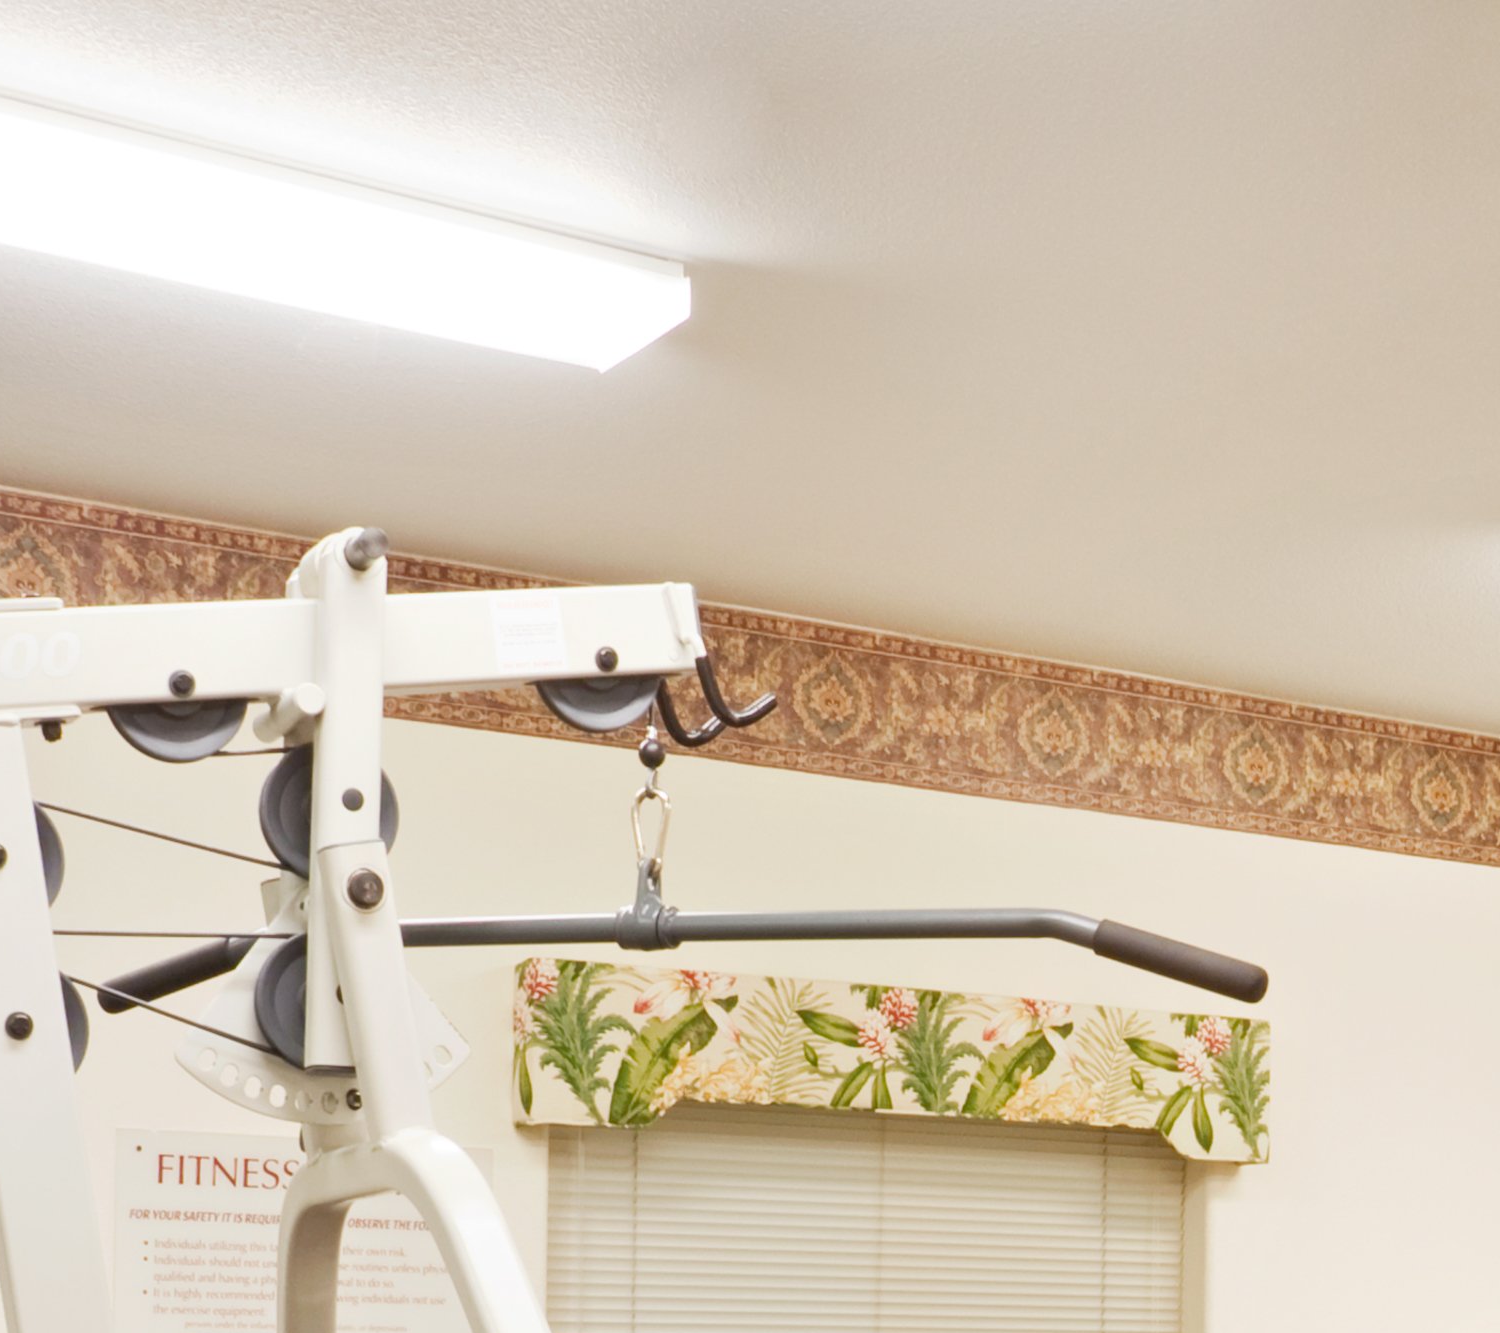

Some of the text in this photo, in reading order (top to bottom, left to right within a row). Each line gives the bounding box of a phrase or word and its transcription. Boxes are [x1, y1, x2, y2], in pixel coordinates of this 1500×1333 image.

[157, 1154, 300, 1189] FITNESS
[129, 1208, 150, 1220] FOR
[152, 1210, 181, 1221] YOUR
[183, 1211, 219, 1223] SAFETY
[222, 1212, 231, 1223] IT
[233, 1213, 243, 1224] IS
[348, 1218, 390, 1230] OBSERVE
[393, 1219, 413, 1231] THE
[154, 1239, 206, 1250] Individuals
[154, 1255, 206, 1267] Individuals
[208, 1256, 242, 1268] should
[197, 1272, 216, 1283] and
